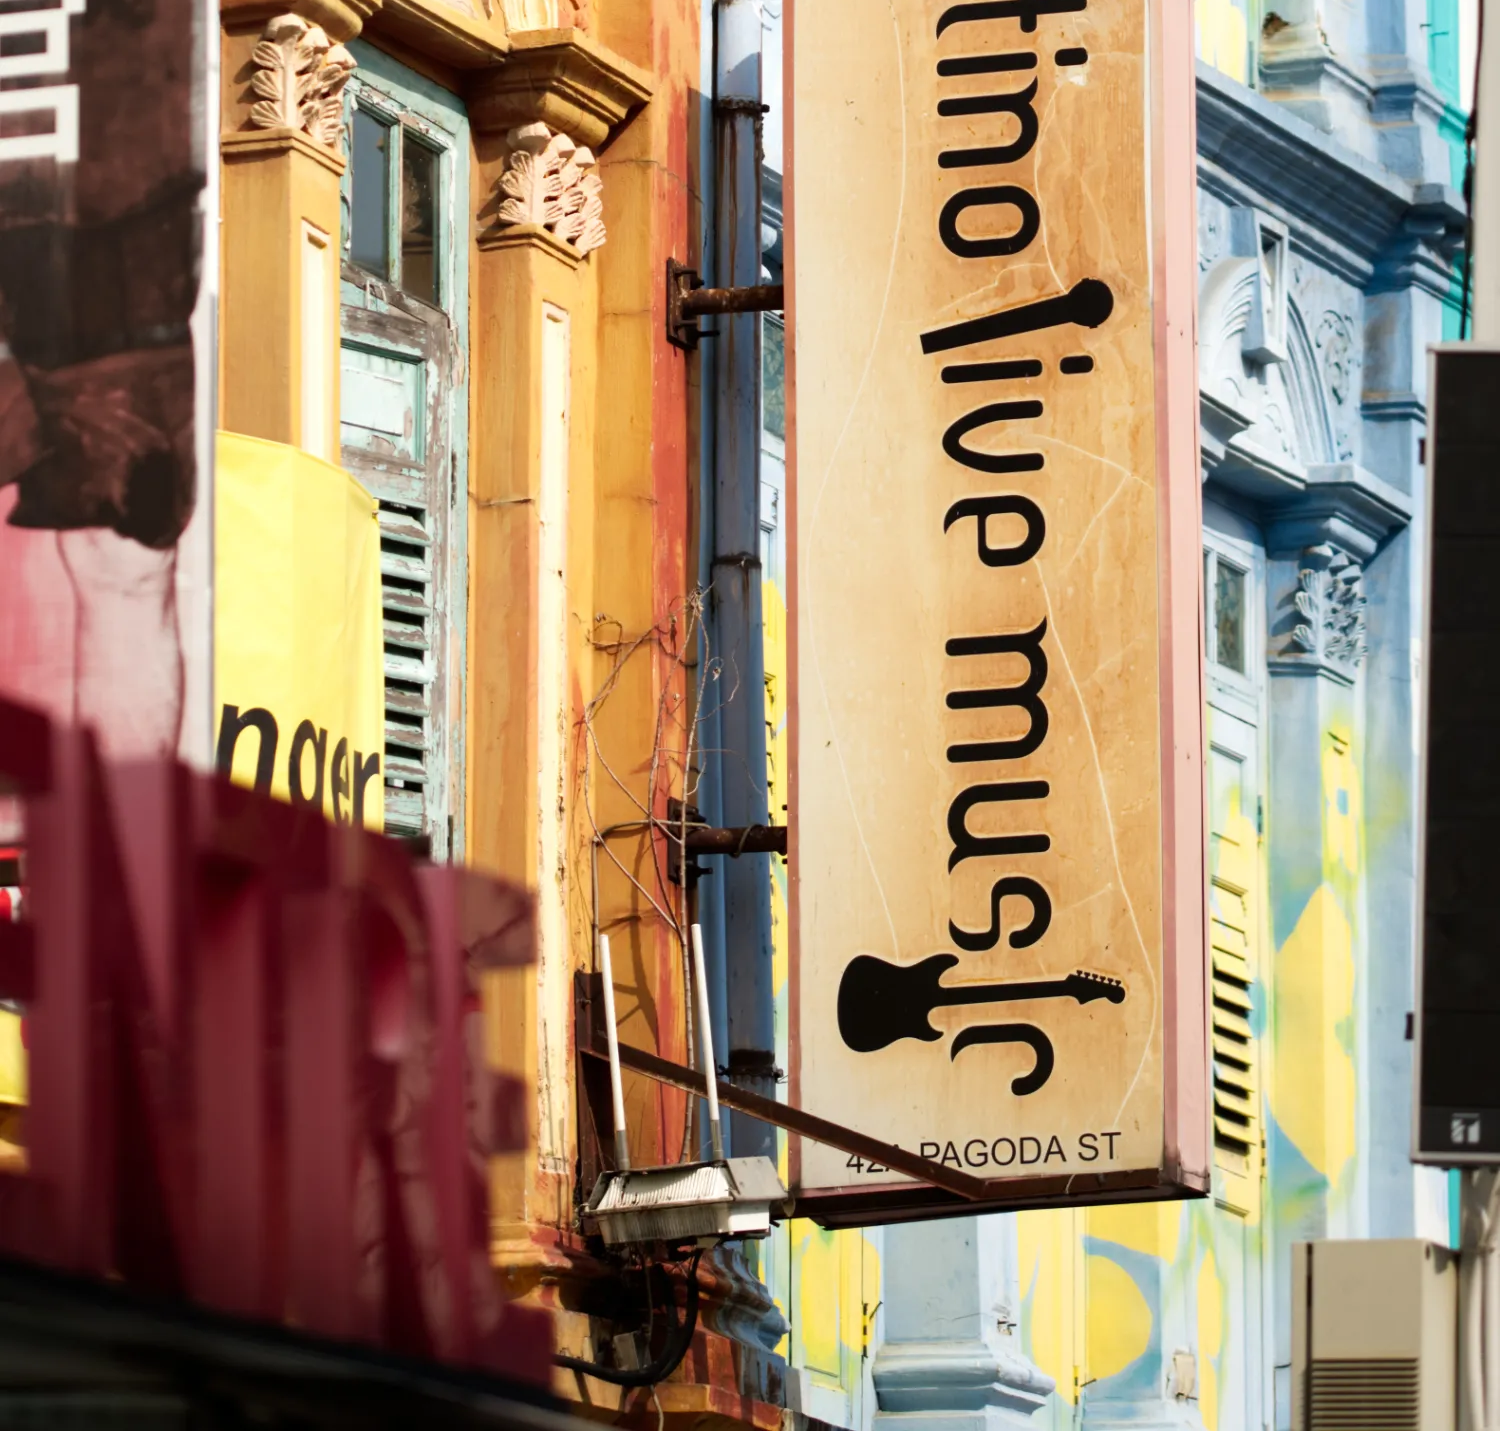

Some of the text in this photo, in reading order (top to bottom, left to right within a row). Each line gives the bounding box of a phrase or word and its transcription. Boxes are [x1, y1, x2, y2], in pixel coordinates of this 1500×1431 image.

[920, 277, 1114, 566] live
[837, 615, 1127, 1095] music
[920, 1135, 1067, 1168] PAGODA
[1078, 1132, 1121, 1161] ST
